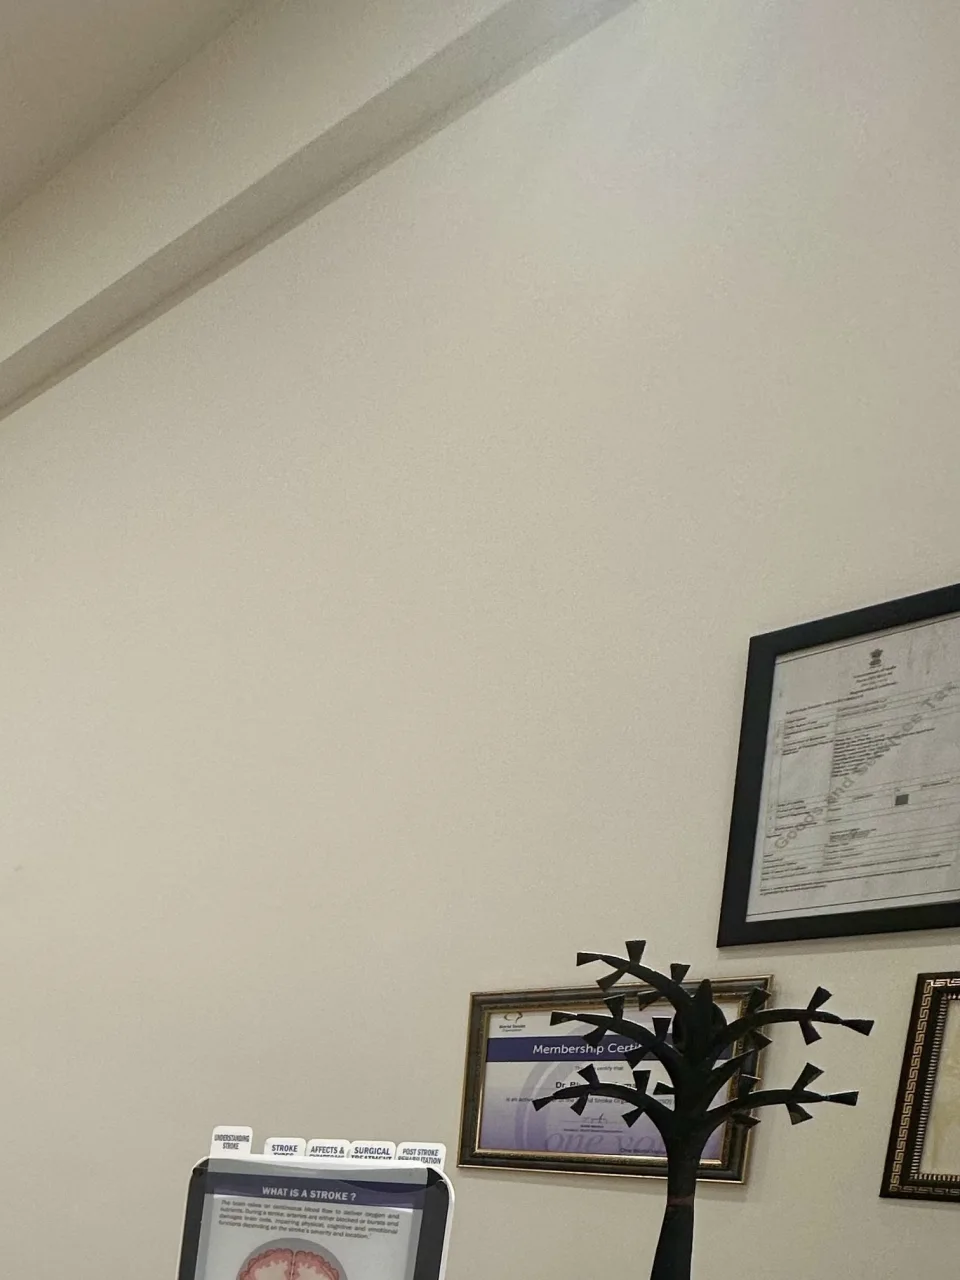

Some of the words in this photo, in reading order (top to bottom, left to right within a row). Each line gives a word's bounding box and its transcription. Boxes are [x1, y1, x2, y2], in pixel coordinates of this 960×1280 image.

[214, 1134, 250, 1142] UNDERSTANDING
[222, 1142, 239, 1150] STROKE
[272, 1144, 298, 1152] STROKE
[311, 1146, 337, 1154] AFFECTS
[354, 1147, 390, 1155] SURGICAL
[262, 1187, 288, 1196] WHAT
[290, 1189, 299, 1197] IS
[301, 1190, 308, 1198] A
[310, 1190, 348, 1200] STROKE
[350, 1192, 357, 1201] ?
